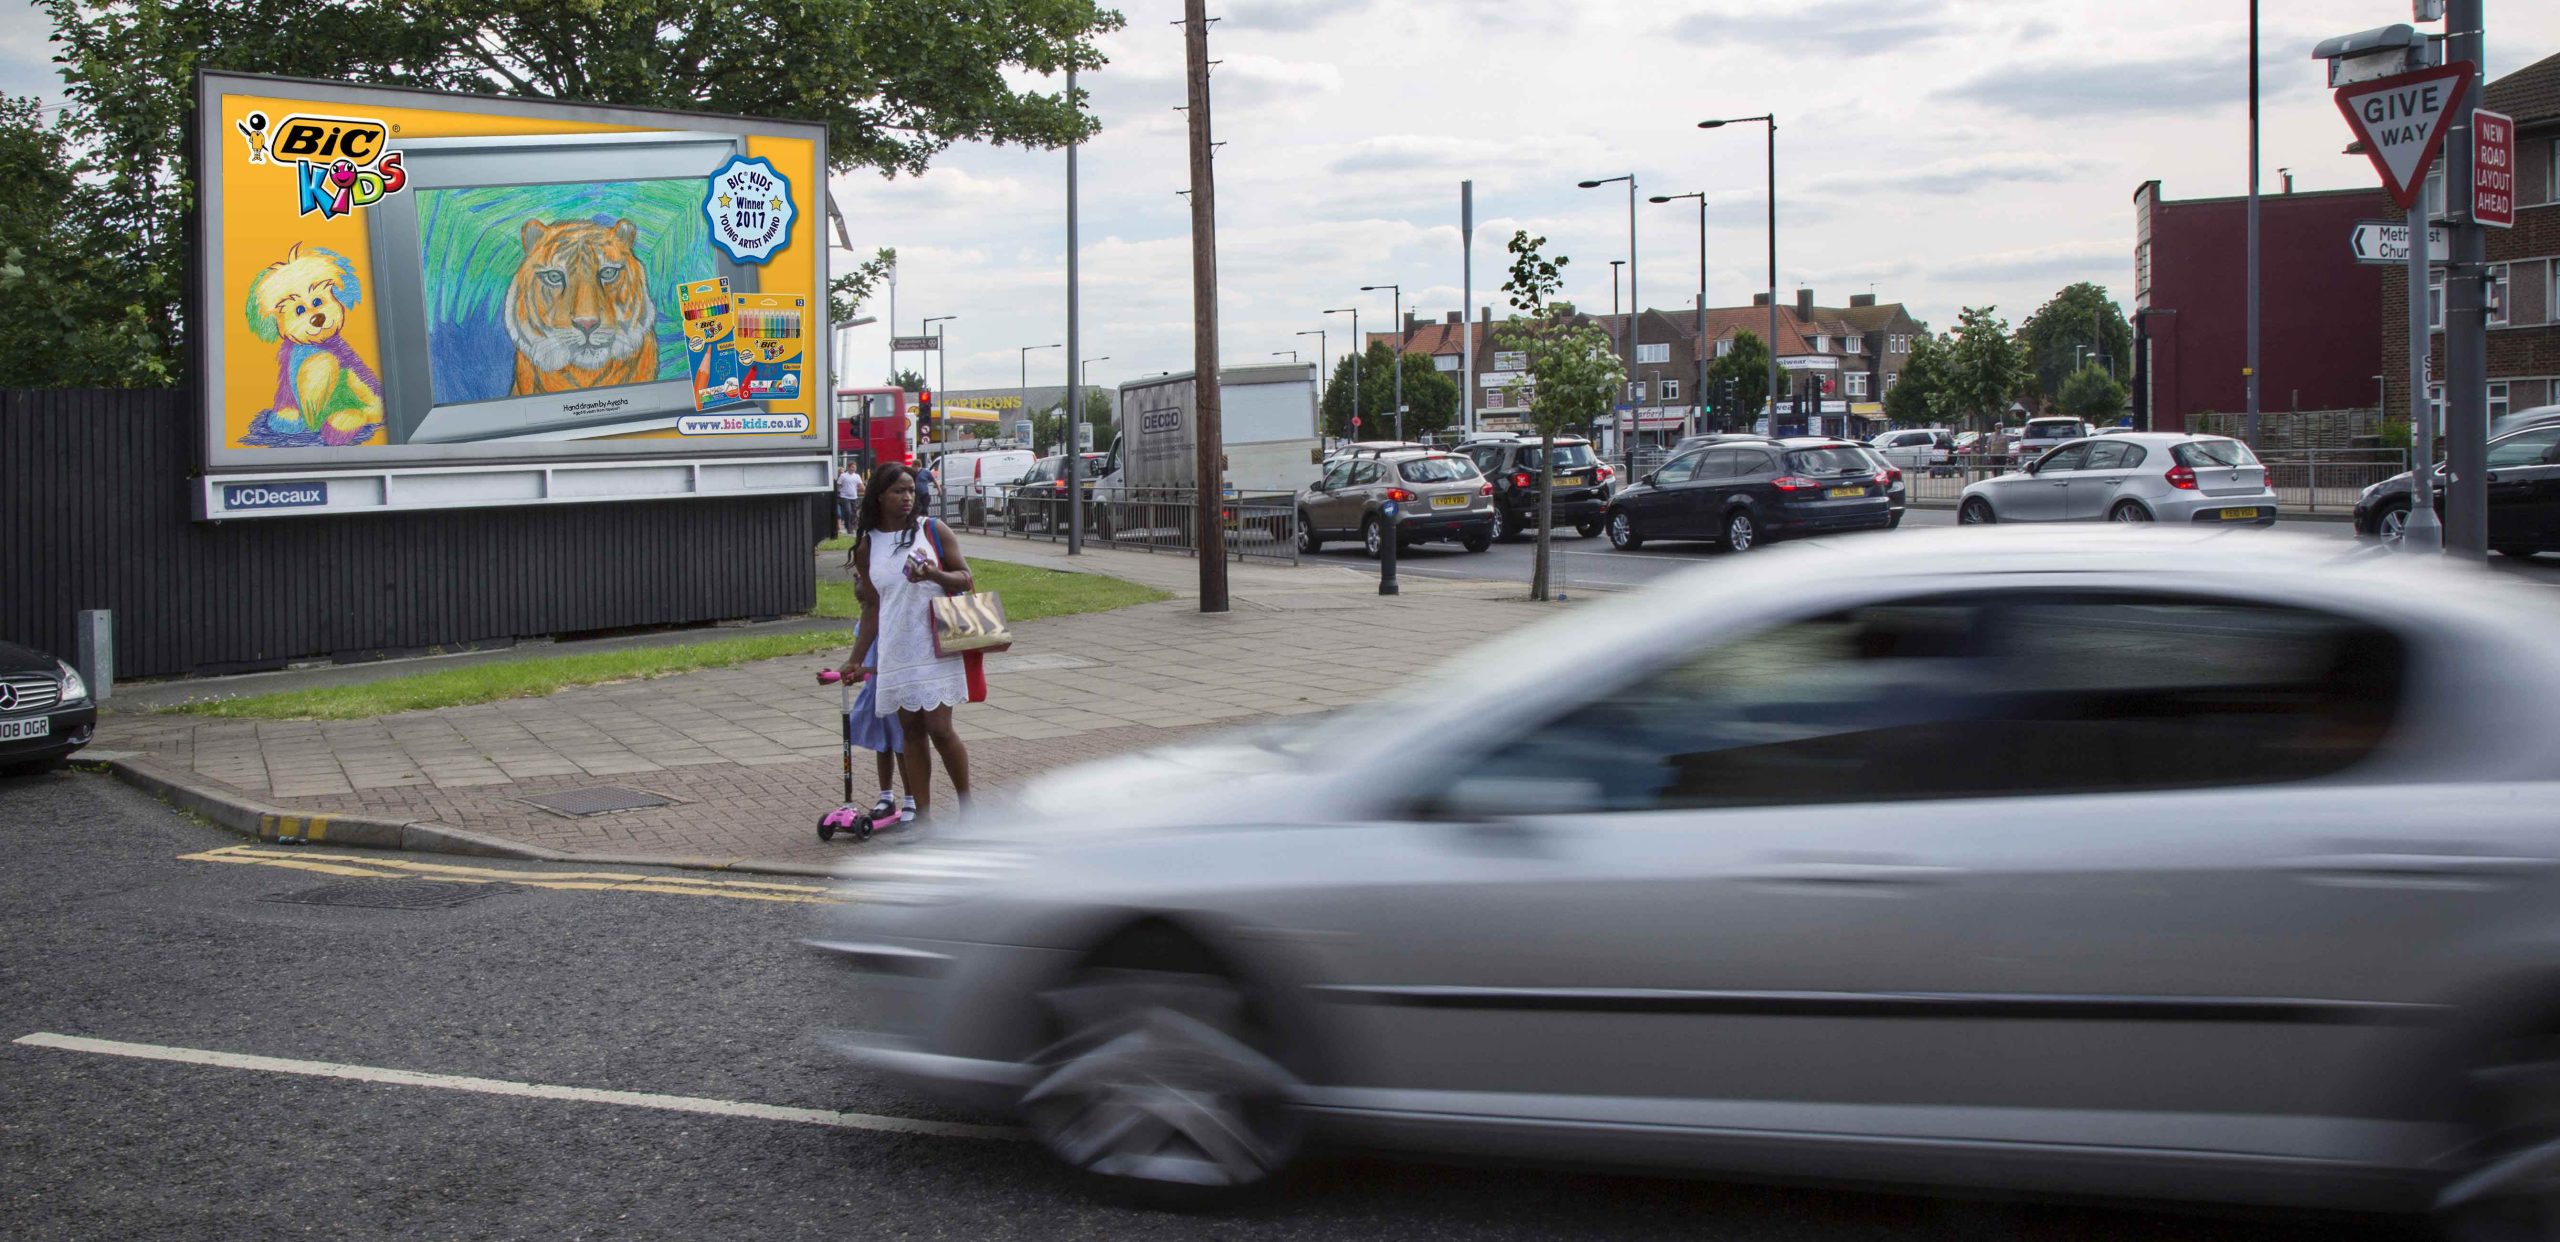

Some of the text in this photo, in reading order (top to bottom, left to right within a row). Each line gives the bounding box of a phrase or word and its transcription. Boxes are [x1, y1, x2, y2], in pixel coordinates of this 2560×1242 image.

[2363, 86, 2440, 124] GIVE
[2381, 122, 2429, 147] WAY
[2482, 123, 2504, 142] NEW
[2480, 145, 2506, 167] ROAD
[750, 171, 773, 191] KIDS
[2476, 168, 2511, 191] LAYOUT
[736, 196, 764, 210] Winner
[2477, 191, 2509, 214] AHEAD
[736, 210, 766, 229] 2017
[719, 213, 781, 249] YOUNG ARTIST AWARD
[2379, 227, 2441, 242] Methst
[2379, 243, 2409, 258] Chur
[563, 398, 629, 412] Hand drawn by Ayesha
[686, 418, 802, 431] www.bickids.co.uk
[1144, 412, 1179, 430] DECCO
[230, 488, 321, 506] JCDecaux
[24, 719, 48, 736] OGR
